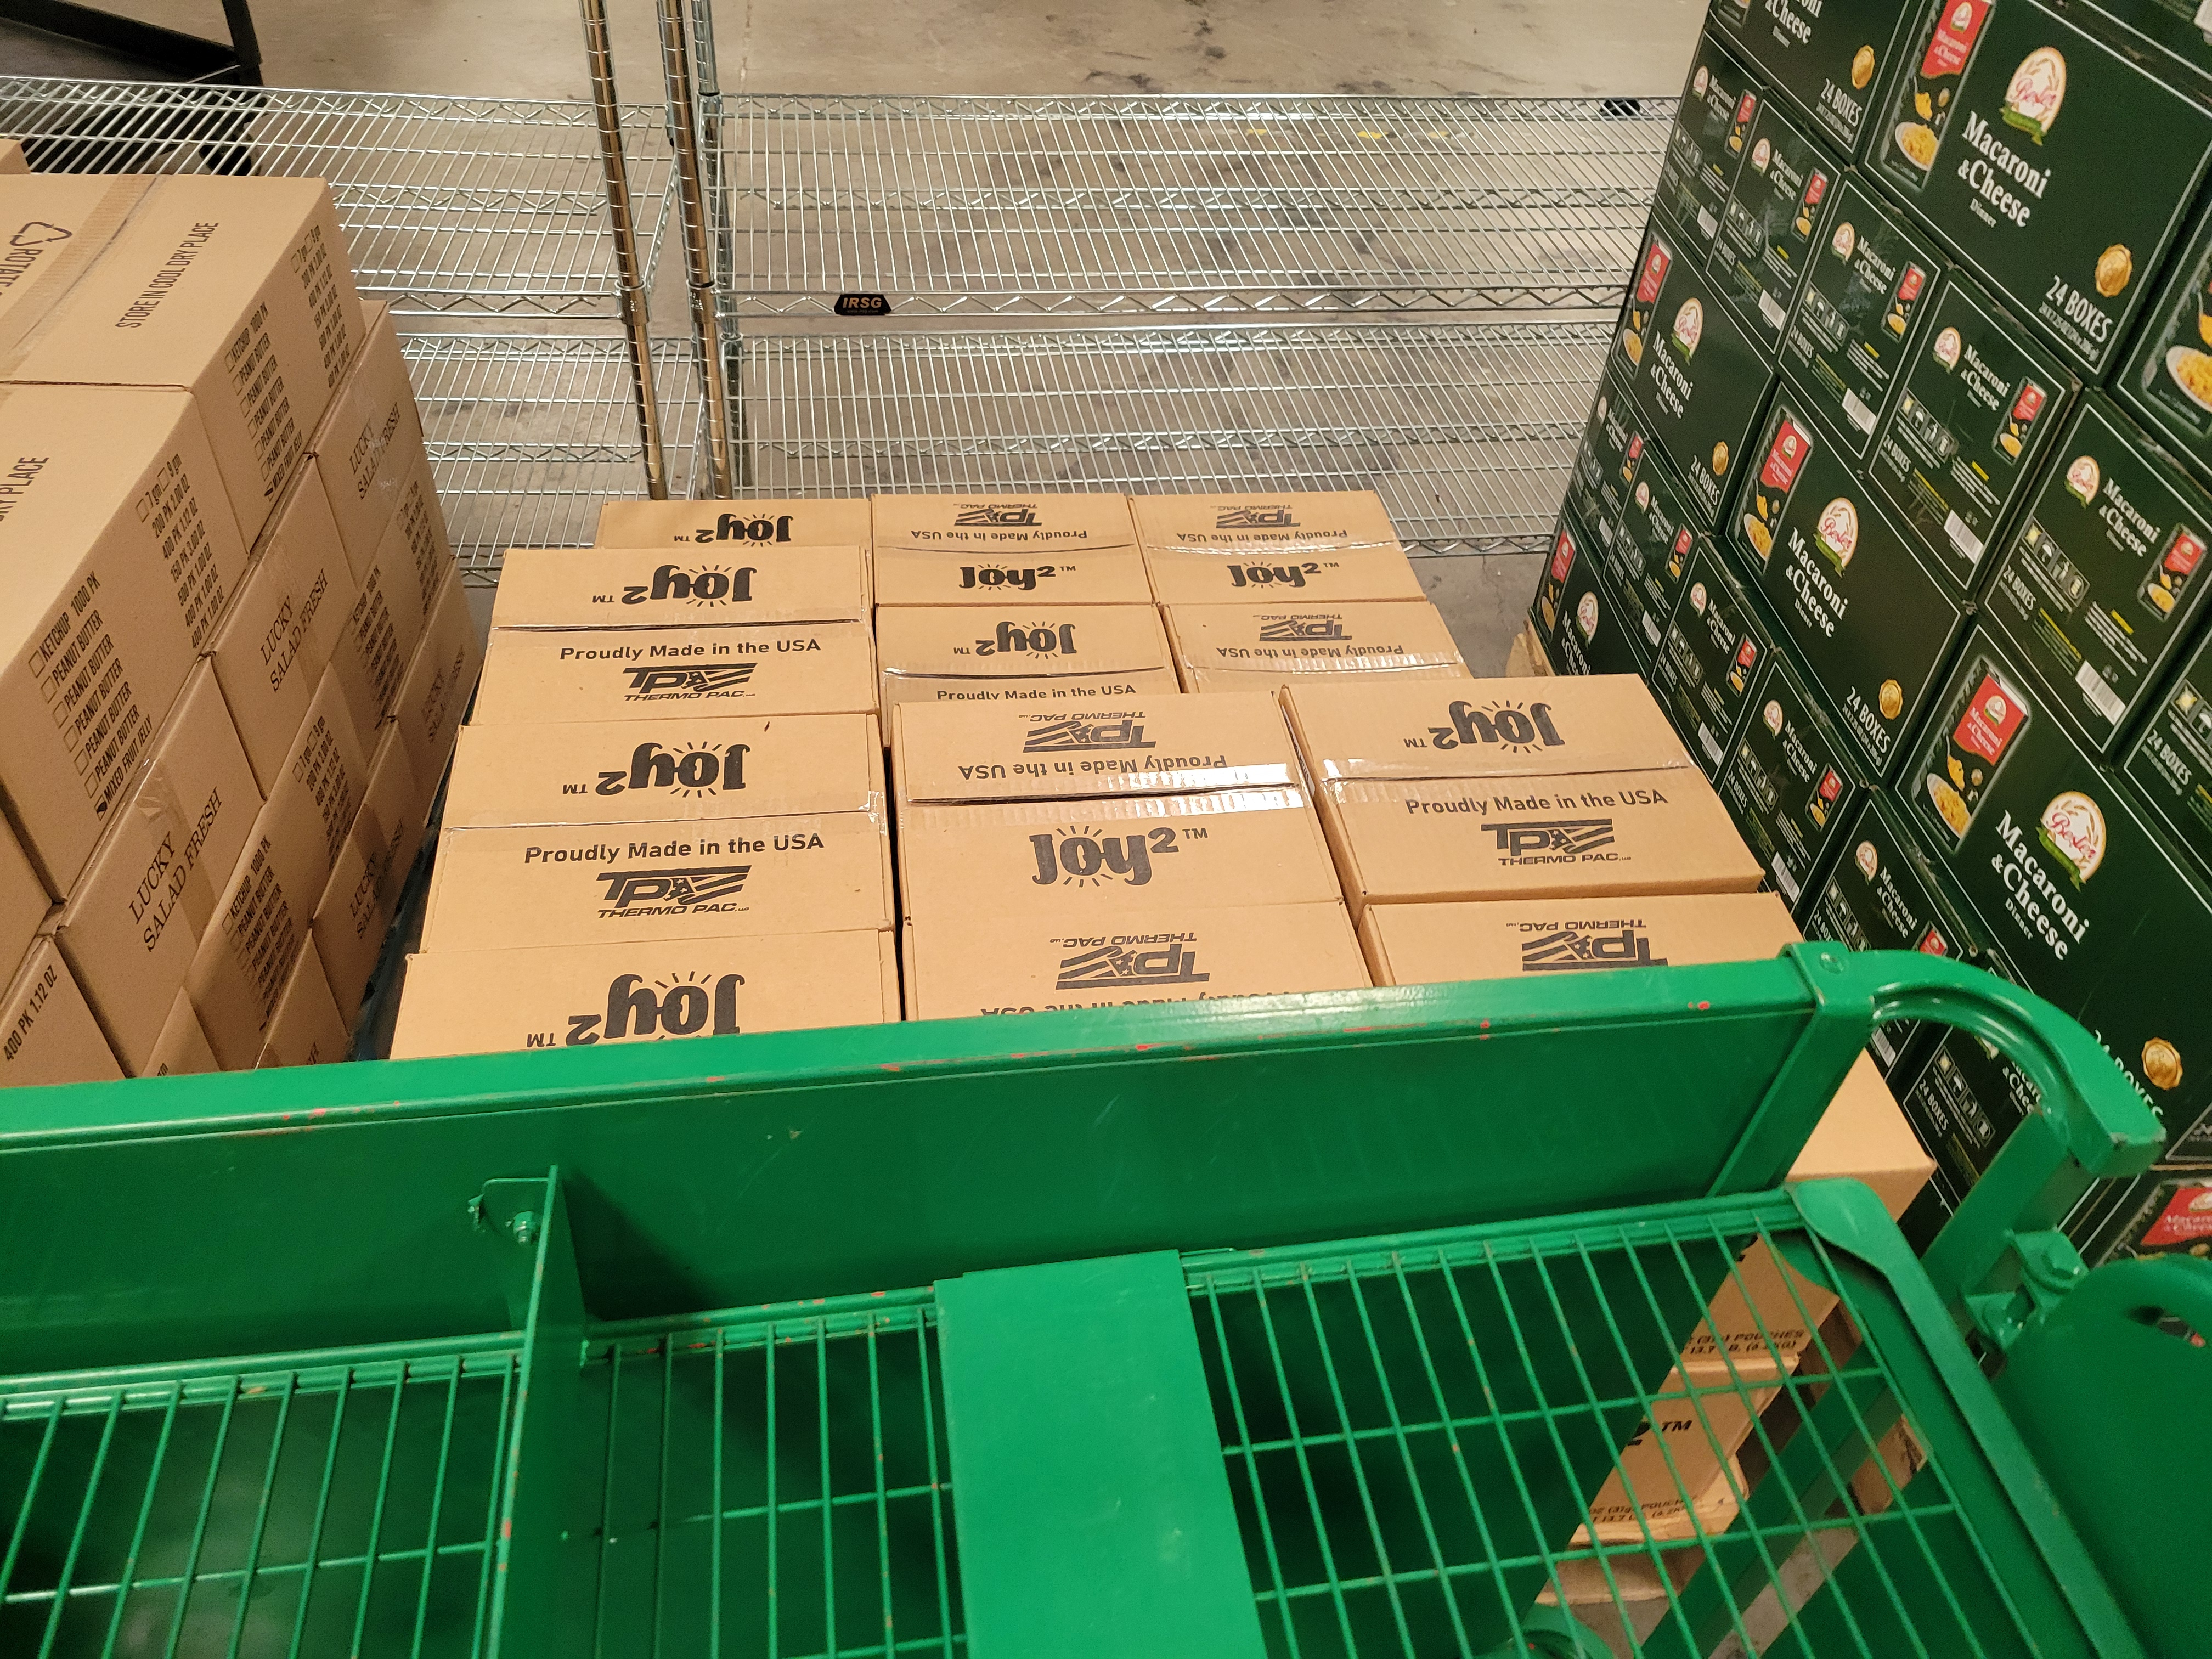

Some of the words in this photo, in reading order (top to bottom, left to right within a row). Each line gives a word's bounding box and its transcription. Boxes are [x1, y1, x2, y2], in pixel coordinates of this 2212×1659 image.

[1821, 78, 1836, 104] 24
[1831, 86, 1863, 127] BOXES
[1962, 111, 2051, 199] Macaroni
[1958, 160, 2030, 228] &Cheese
[180, 222, 219, 248] PLACE
[165, 250, 198, 266] DRY
[138, 290, 168, 298] IN
[149, 267, 185, 289] COOL
[115, 301, 160, 328] STORE
[843, 297, 882, 308] IRSG
[2046, 275, 2069, 306] 24
[2064, 290, 2113, 342] BOXES
[1652, 330, 1694, 401] Macaroni
[0, 457, 50, 494] PLACE
[1690, 454, 1700, 478] 24
[1699, 466, 1720, 506] BOXES
[152, 512, 165, 539] 200
[162, 500, 173, 523] PK
[180, 473, 190, 494] OZ
[171, 523, 182, 545] PK
[189, 496, 199, 517] OZ
[2103, 477, 2161, 544] Macaroni
[179, 547, 190, 569] PK
[196, 520, 206, 540] OZ
[910, 530, 943, 541] USA
[947, 531, 970, 541] the
[992, 532, 1029, 541] Made
[1034, 530, 1088, 541] Proudly
[1176, 532, 1207, 543] USA
[1210, 533, 1234, 543] the
[1253, 532, 1290, 541] Made
[1295, 529, 1348, 541] Proudly
[187, 570, 197, 591] PK
[204, 541, 212, 561] OZ
[1787, 527, 1848, 620] Macaroni
[194, 591, 204, 613] PK
[210, 563, 218, 583] OZ
[1786, 564, 1835, 638] &Cheese
[40, 612, 71, 662] KETCHUP
[71, 585, 89, 617] 1000
[87, 571, 101, 595] PK
[200, 615, 210, 634] PK
[216, 585, 224, 605] OZ
[52, 645, 80, 687] PEANUT
[78, 610, 104, 650] BUTTER
[261, 595, 293, 666] LUCKY
[270, 625, 301, 693] SALAD
[300, 568, 328, 633] FRESH
[560, 646, 643, 662] Proudly
[650, 644, 706, 658] Made
[712, 642, 730, 655] in
[737, 641, 770, 654] the
[776, 639, 822, 653] USA
[1215, 646, 1250, 658] USA
[1254, 647, 1279, 658] the
[1282, 647, 1297, 657] in
[1300, 646, 1341, 657] Made
[1346, 645, 1404, 656] Proudly
[64, 668, 92, 712] PEANUT
[88, 634, 114, 676] BUTTER
[936, 689, 1000, 701] Proudly
[1005, 688, 1047, 700] Made
[1052, 687, 1066, 698] in
[1071, 686, 1097, 697] the
[1101, 684, 1137, 696] USA
[75, 692, 101, 736] PEANUT
[99, 658, 123, 700] BUTTER
[624, 692, 702, 702] THERMO
[85, 716, 110, 759] PEANUT
[108, 681, 132, 724] BUTTER
[1071, 712, 1146, 722] THERMO
[1847, 686, 1861, 712] 24
[1859, 703, 1891, 754] BOXES
[95, 739, 119, 782] PEANUT
[117, 704, 140, 746] BUTTER
[104, 766, 125, 804] MIXED
[122, 742, 140, 773] FRUIT
[138, 714, 153, 747] JELLY
[1146, 754, 1228, 771] Proudly
[1785, 720, 1819, 775] Macaroni
[958, 764, 1006, 780] USA
[1014, 763, 1048, 778] the
[1054, 760, 1074, 775] in
[1080, 758, 1139, 773] Made
[2160, 743, 2187, 785] BOXES
[1405, 797, 1488, 816] Proudly
[1494, 795, 1551, 811] Made
[1556, 793, 1576, 809] in
[1581, 792, 1617, 808] the
[1621, 789, 1669, 805] USA
[524, 846, 620, 865] Proudly
[627, 842, 692, 859] Made
[699, 839, 720, 855] in
[727, 837, 766, 853] the
[774, 832, 825, 851] USA
[1498, 856, 1577, 867] THERMO
[128, 831, 175, 925] LUCKY
[143, 865, 186, 952] SALAD
[184, 786, 222, 871] FRESH
[1995, 809, 2090, 945] Macaroni
[230, 875, 251, 918] KETCHUP
[597, 906, 689, 918] THERMO
[1880, 866, 1918, 931] Macaroni
[1991, 854, 2068, 960] &Cheese
[1565, 919, 1647, 929] THERMO
[2005, 898, 2033, 940] Dinner
[1110, 932, 1198, 946] THERMO
[3, 1030, 22, 1062] 400
[18, 1010, 34, 1035] PK
[30, 983, 48, 1013] 1.12
[44, 964, 57, 988] OZ
